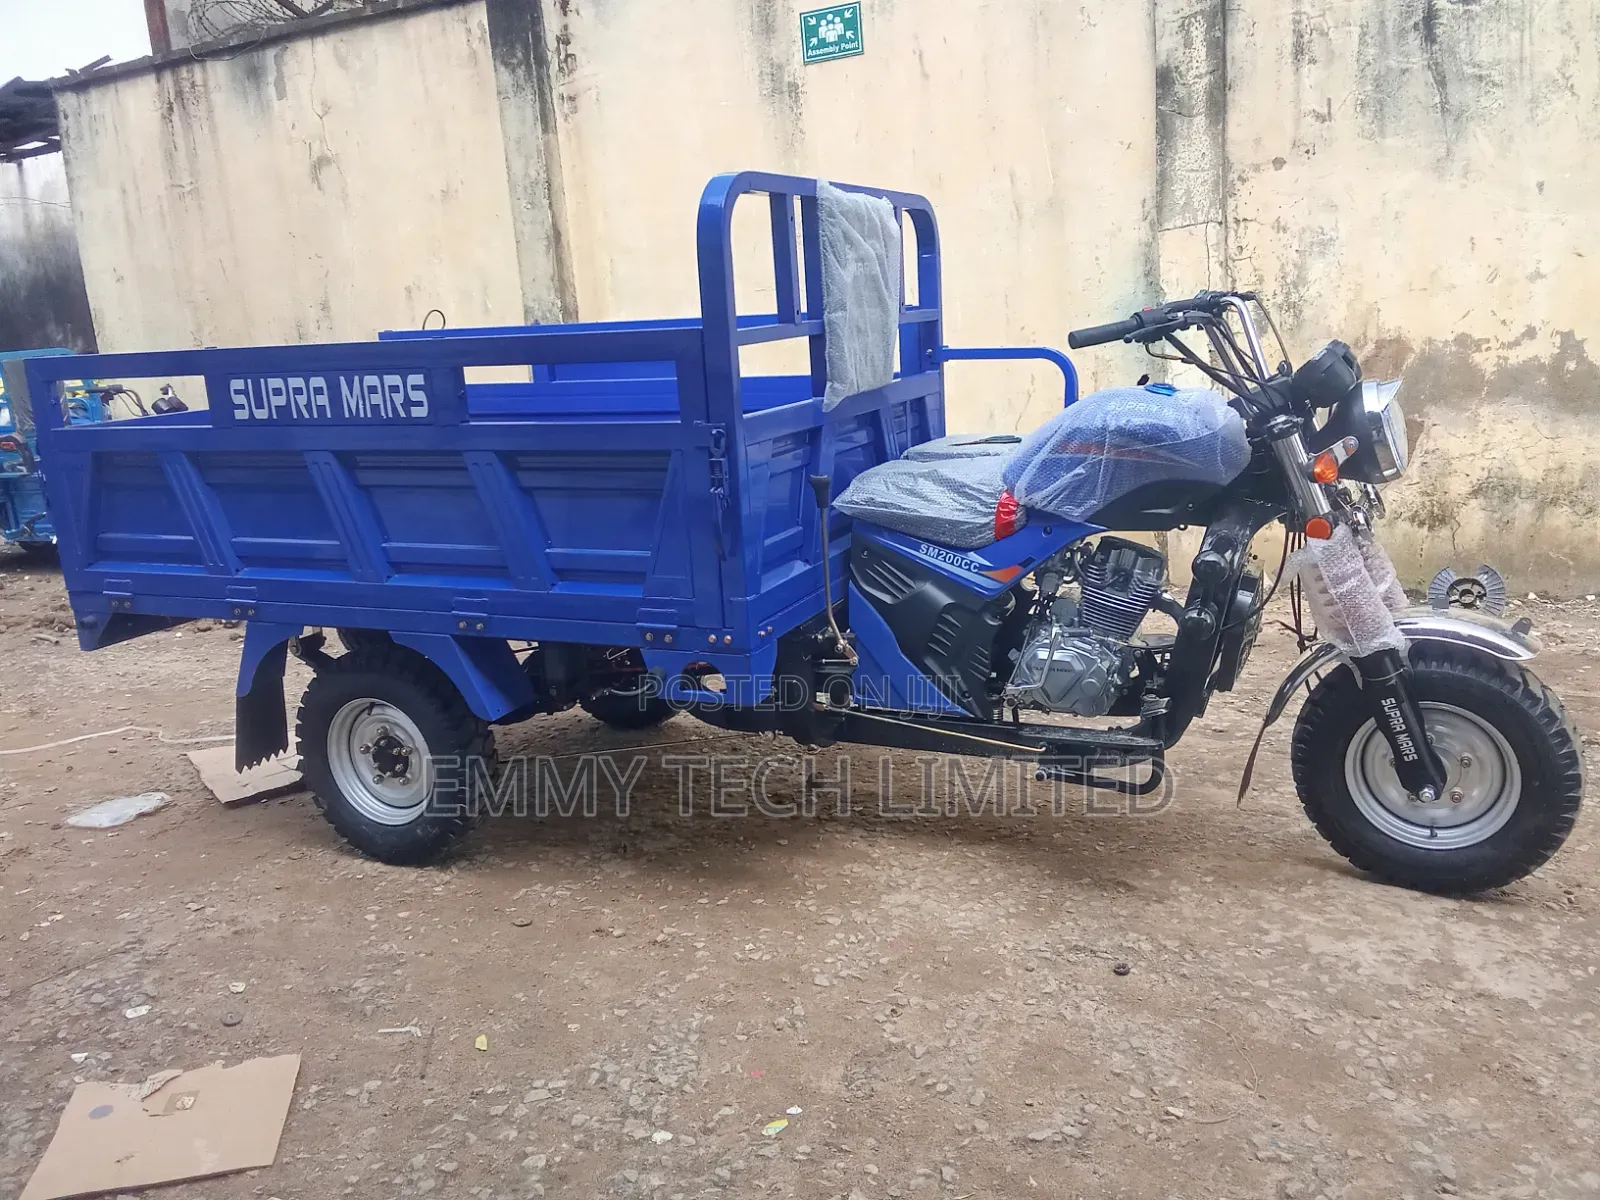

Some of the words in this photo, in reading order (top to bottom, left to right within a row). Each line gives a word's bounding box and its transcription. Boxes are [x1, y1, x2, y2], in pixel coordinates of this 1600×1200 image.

[808, 44, 840, 57] Assembly
[840, 41, 859, 51] Point
[229, 376, 332, 420] SUPRA
[339, 374, 429, 419] MARS
[919, 543, 981, 573] SM200CC
[1380, 697, 1407, 733] SUPRA
[1395, 732, 1419, 762] MARS
